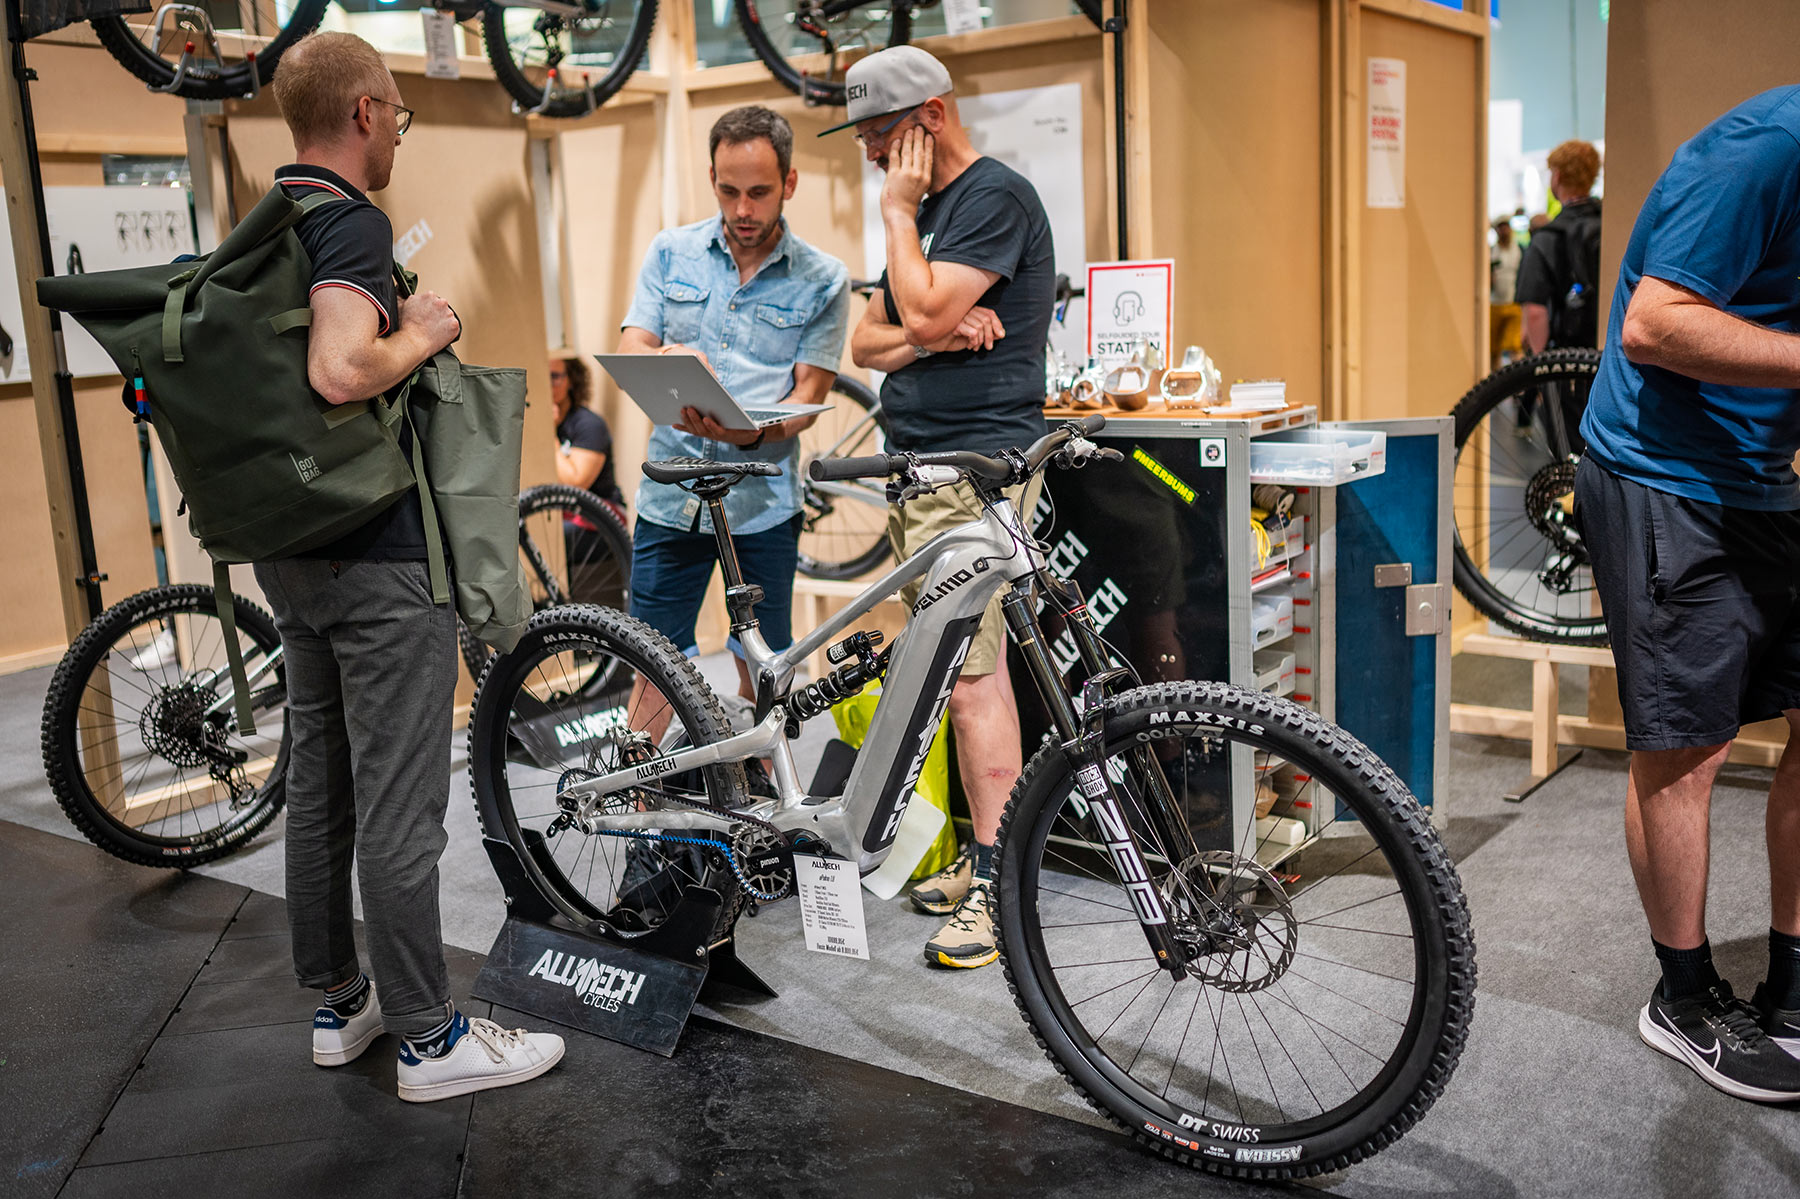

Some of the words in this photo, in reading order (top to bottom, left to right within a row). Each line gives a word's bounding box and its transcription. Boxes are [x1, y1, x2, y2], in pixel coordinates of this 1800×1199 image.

[1097, 341, 1160, 354] STATN
[1535, 363, 1598, 376] MAXXI
[298, 455, 316, 471] GOT
[302, 466, 323, 482] BAG.
[131, 597, 199, 623] MAXXIS
[543, 632, 612, 648] MAXXIS
[1149, 711, 1266, 737] MAXXIS
[636, 757, 677, 780] ALUTECH
[1080, 767, 1101, 784] ROCK
[1085, 780, 1105, 796] SHOX
[760, 857, 780, 869] pinion
[1089, 799, 1167, 926] ZEB
[528, 949, 646, 1005] ALUTECH
[583, 992, 621, 1013] CYCLES
[1177, 1112, 1208, 1133] DT
[1209, 1123, 1261, 1144] SWISS
[1234, 1144, 1303, 1164] ASSEGAI
